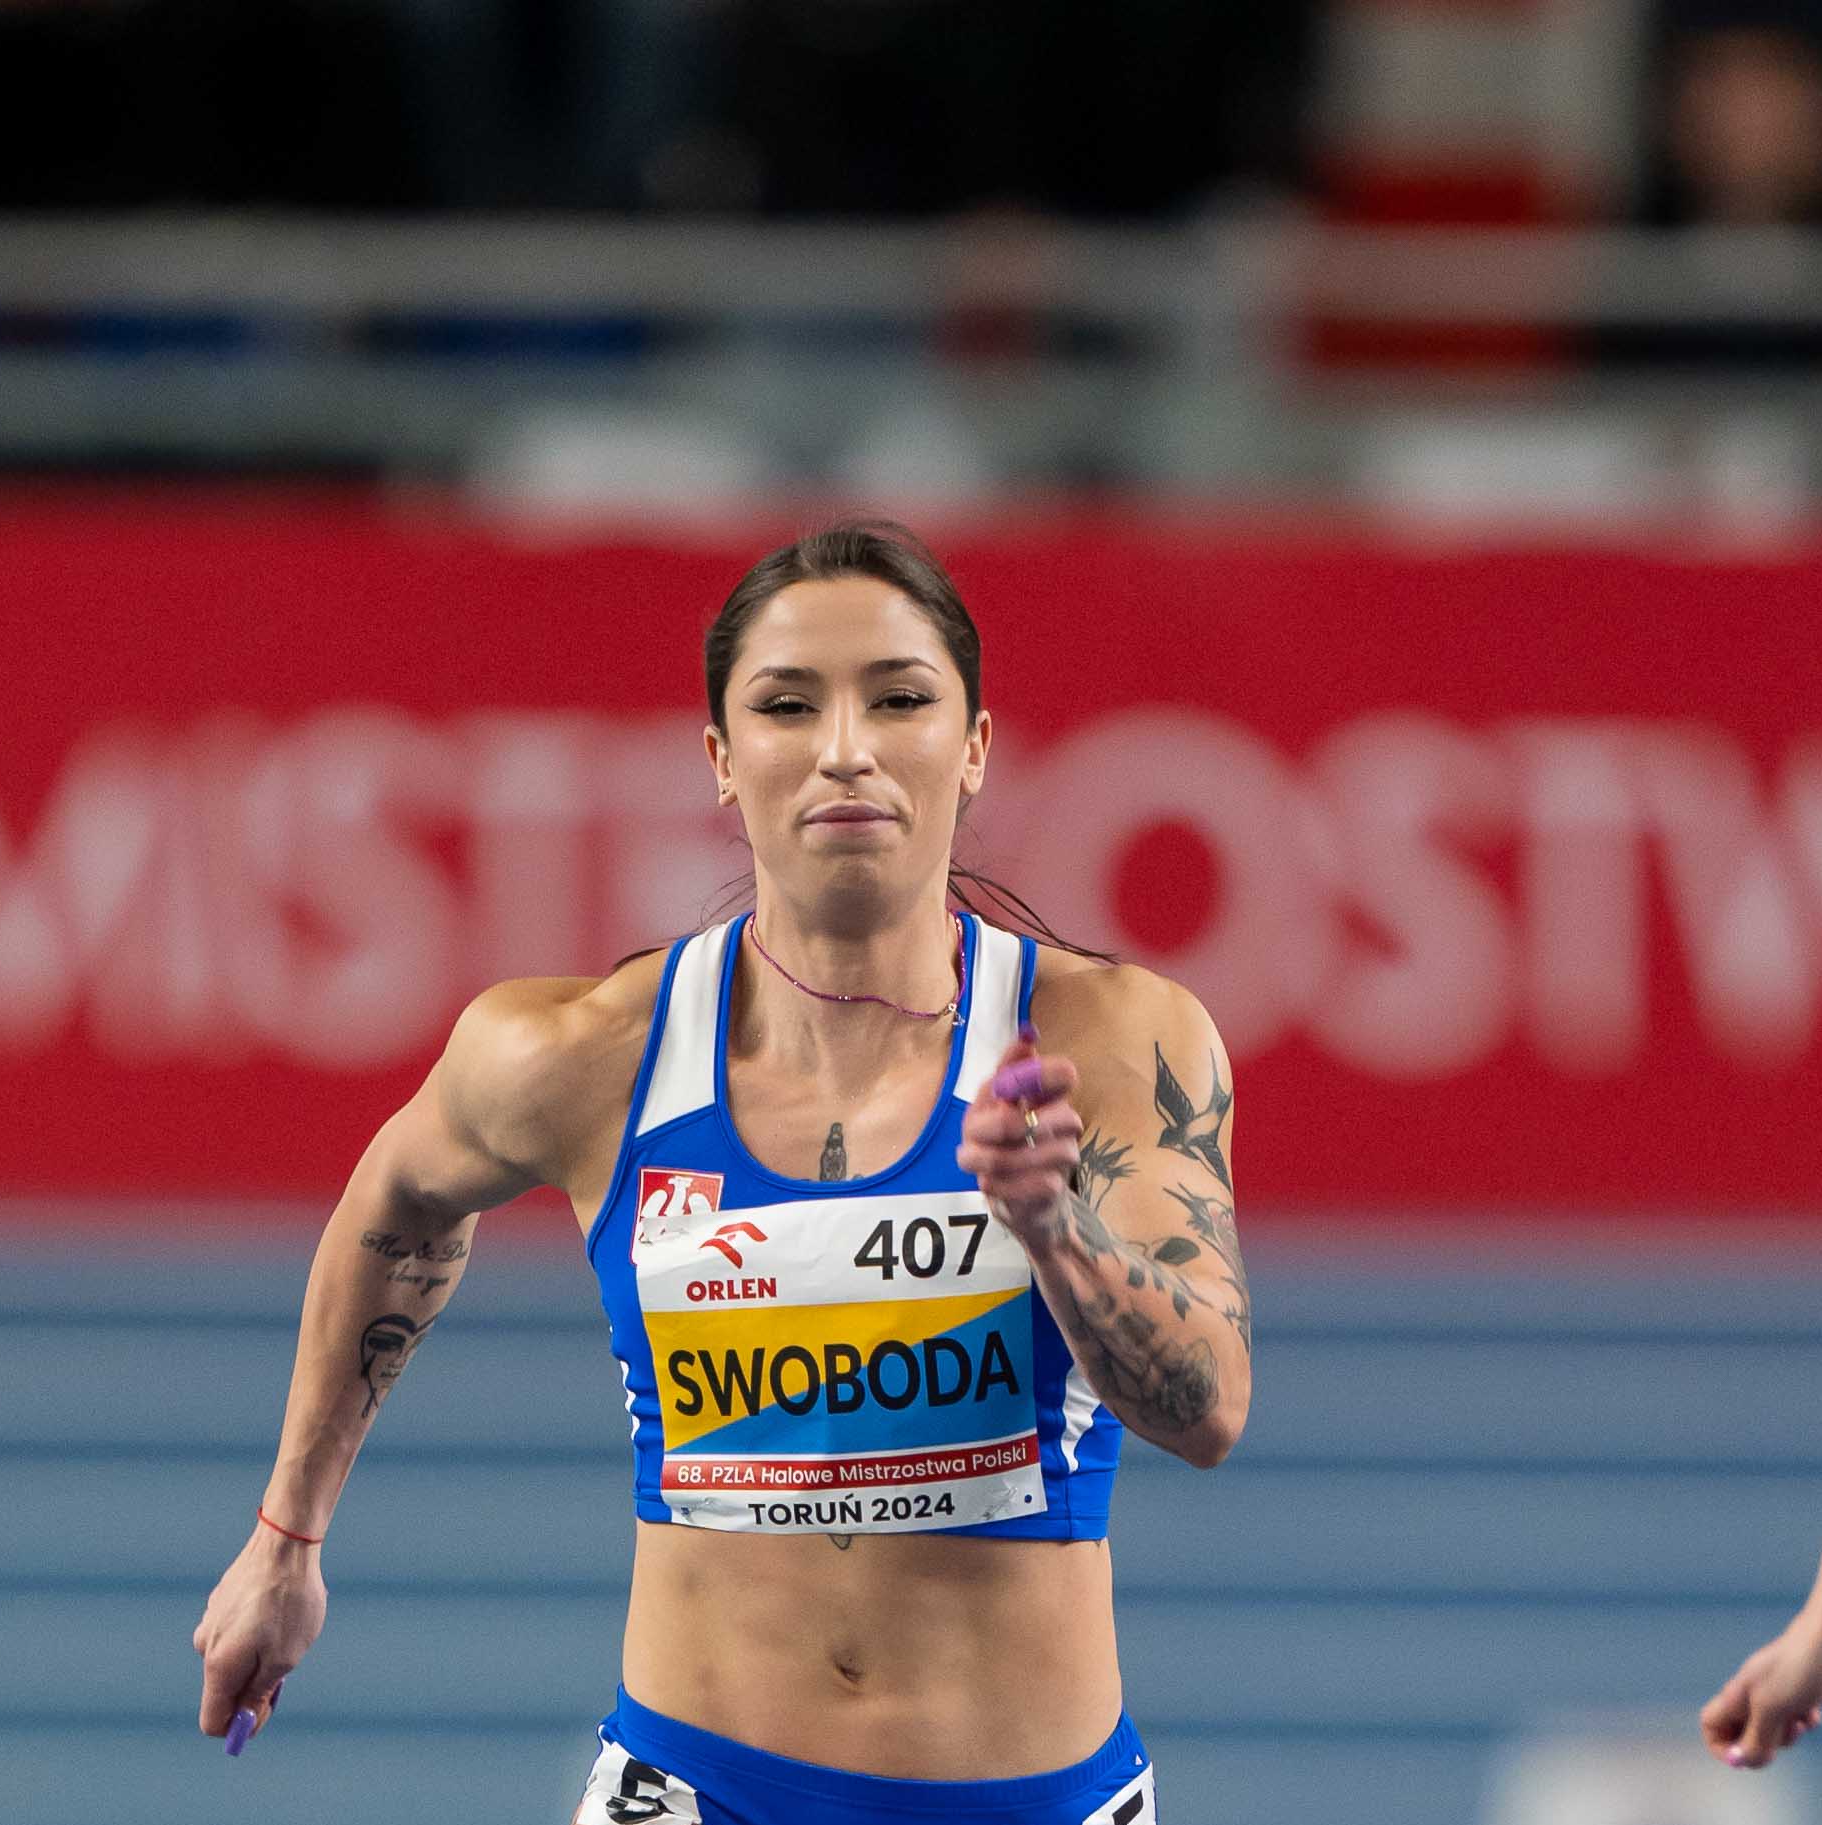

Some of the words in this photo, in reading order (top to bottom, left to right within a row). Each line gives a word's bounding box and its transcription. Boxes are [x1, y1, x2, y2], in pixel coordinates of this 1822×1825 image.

[853, 1213, 989, 1281] 407
[685, 1277, 777, 1302] ORLEN
[667, 1330, 1020, 1417] SWOBODA
[677, 1465, 706, 1483] 68.
[711, 1466, 756, 1484] PZLA
[761, 1466, 834, 1484] Halowe
[839, 1456, 967, 1482] Mistrzostwa
[972, 1442, 1027, 1471] Polski
[748, 1493, 863, 1526] TORUŃ
[871, 1492, 955, 1522] 2024
